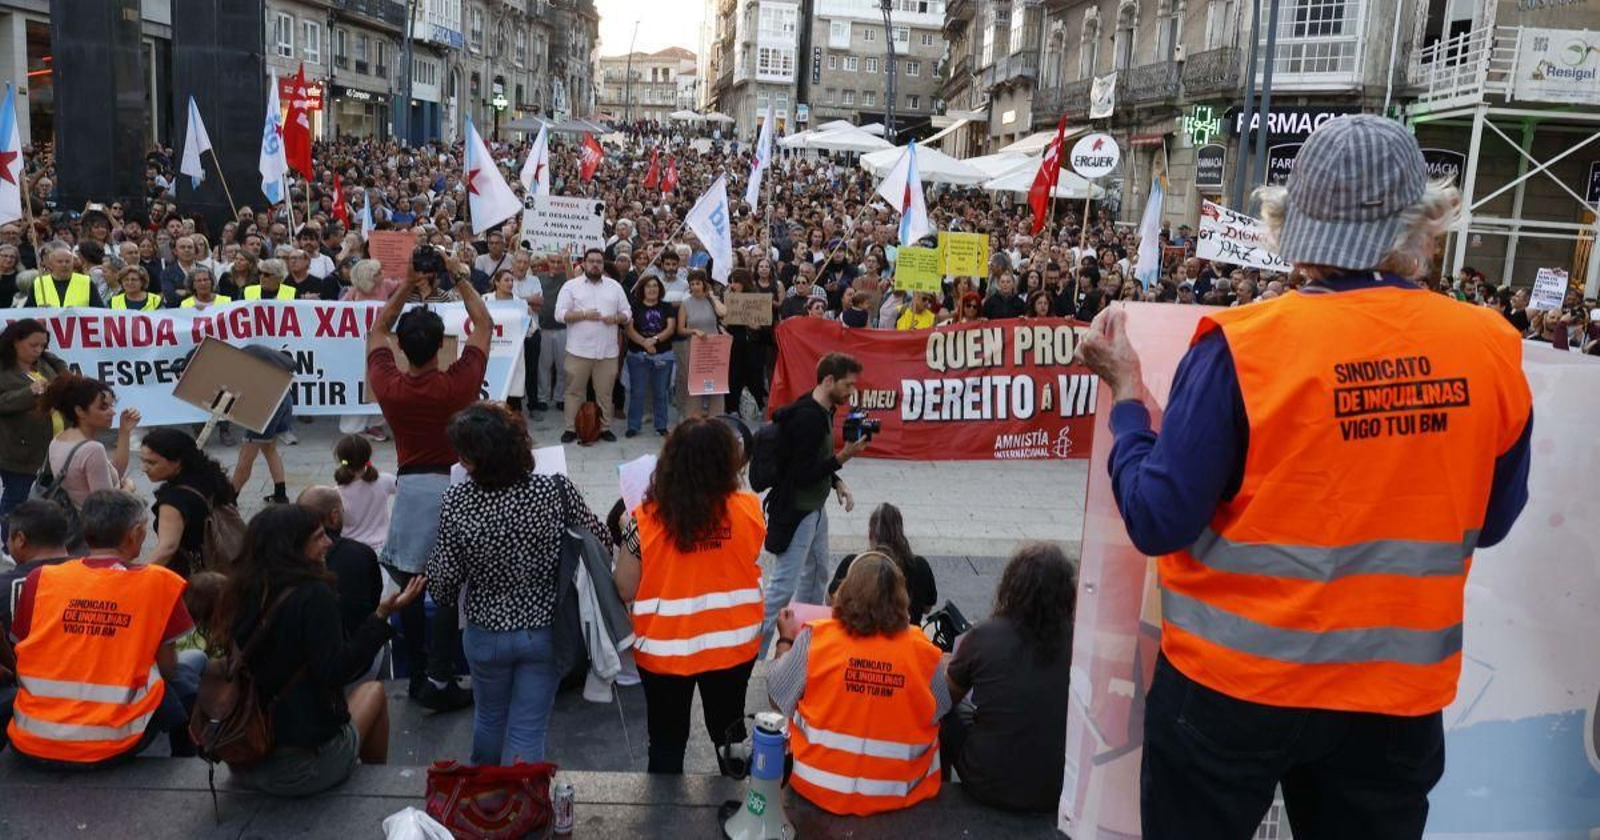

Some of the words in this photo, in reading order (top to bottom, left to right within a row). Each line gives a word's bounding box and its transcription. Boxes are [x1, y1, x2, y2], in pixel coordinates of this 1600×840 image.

[1546, 64, 1596, 80] Resigal
[1236, 112, 1347, 134] FARMAC
[1073, 155, 1114, 168] ERGUER
[1425, 162, 1459, 175] MACIA
[1216, 240, 1257, 262] PAZ
[192, 305, 302, 344] DIGNA
[926, 327, 1003, 372] QUEN
[1334, 355, 1431, 384] SINDICATO
[862, 389, 897, 409] MEU
[901, 374, 1035, 421] DEREITO
[1338, 390, 1361, 413] DE
[1363, 381, 1466, 410] INQUILINAS
[1340, 417, 1381, 441] VIGO
[1385, 415, 1416, 436] TUI
[1419, 412, 1448, 433] BM
[994, 429, 1049, 450] AMNISTÍA
[993, 447, 1050, 459] INTERNACIONAL
[69, 598, 118, 611] SINDICATO
[64, 623, 85, 634] VIGO
[848, 657, 893, 672] SINDICATO
[846, 682, 865, 693] VIGO
